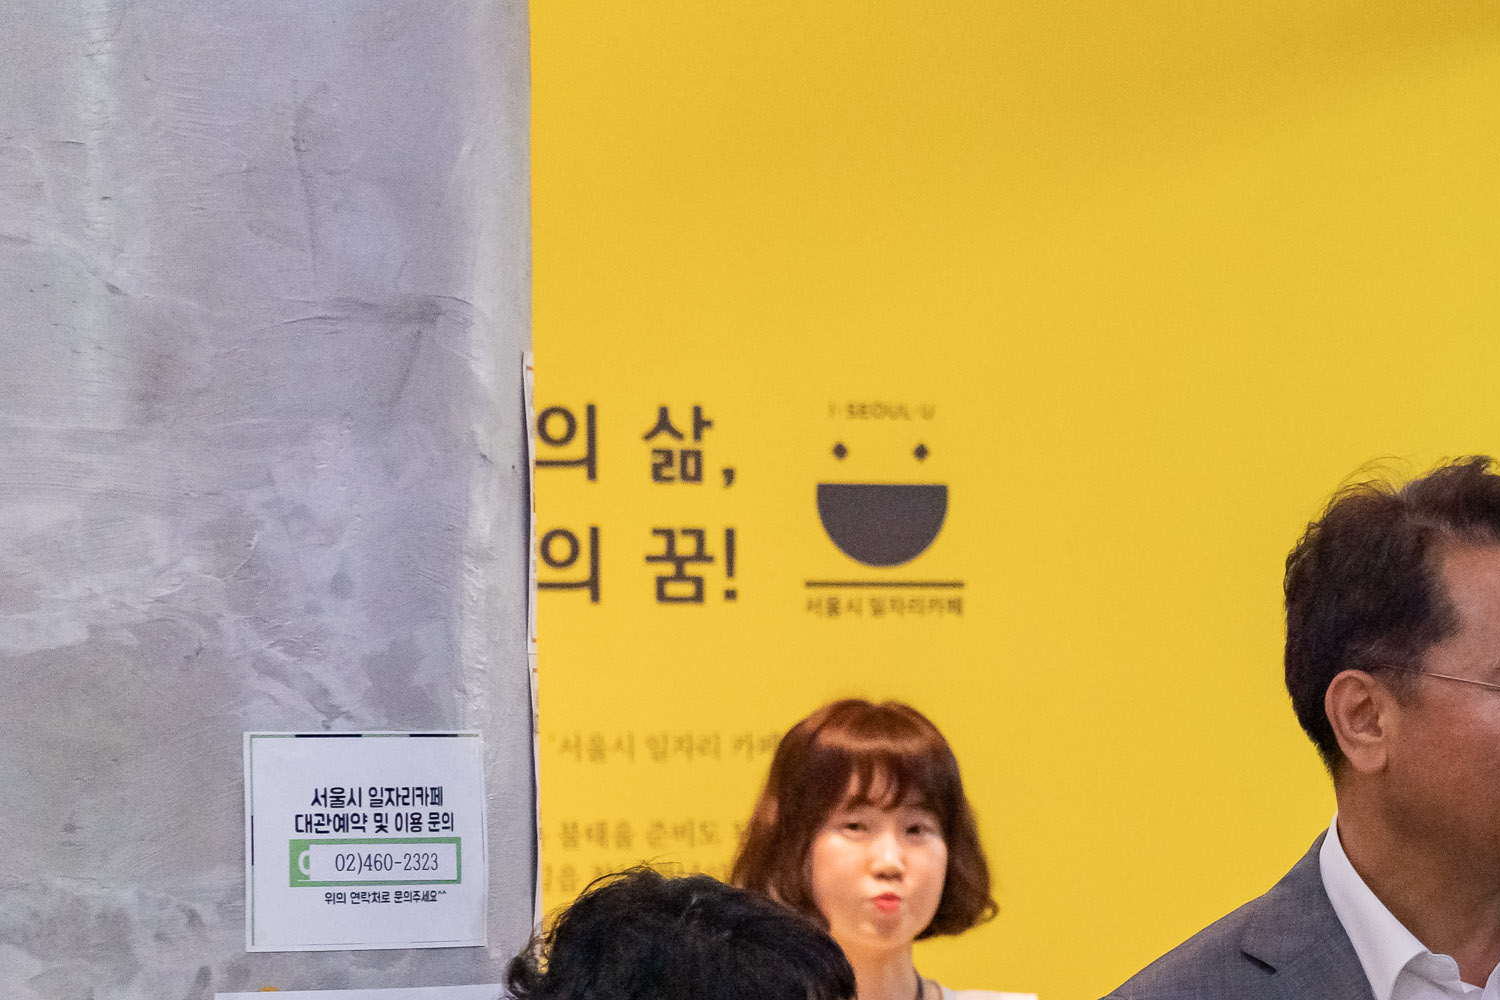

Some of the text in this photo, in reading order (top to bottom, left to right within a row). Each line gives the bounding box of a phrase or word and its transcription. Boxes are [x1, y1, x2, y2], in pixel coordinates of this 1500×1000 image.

[642, 404, 738, 488] 삶,
[645, 526, 739, 605] 꿈!
[805, 597, 863, 618] 서울시
[645, 732, 722, 763] 일자리
[311, 785, 443, 808] 서울시 일자리카페
[295, 811, 454, 834] 대관예약 및 이용 문의
[335, 852, 439, 875] 02)460-2323
[324, 891, 347, 905] 위의
[350, 890, 391, 904] 연락처로
